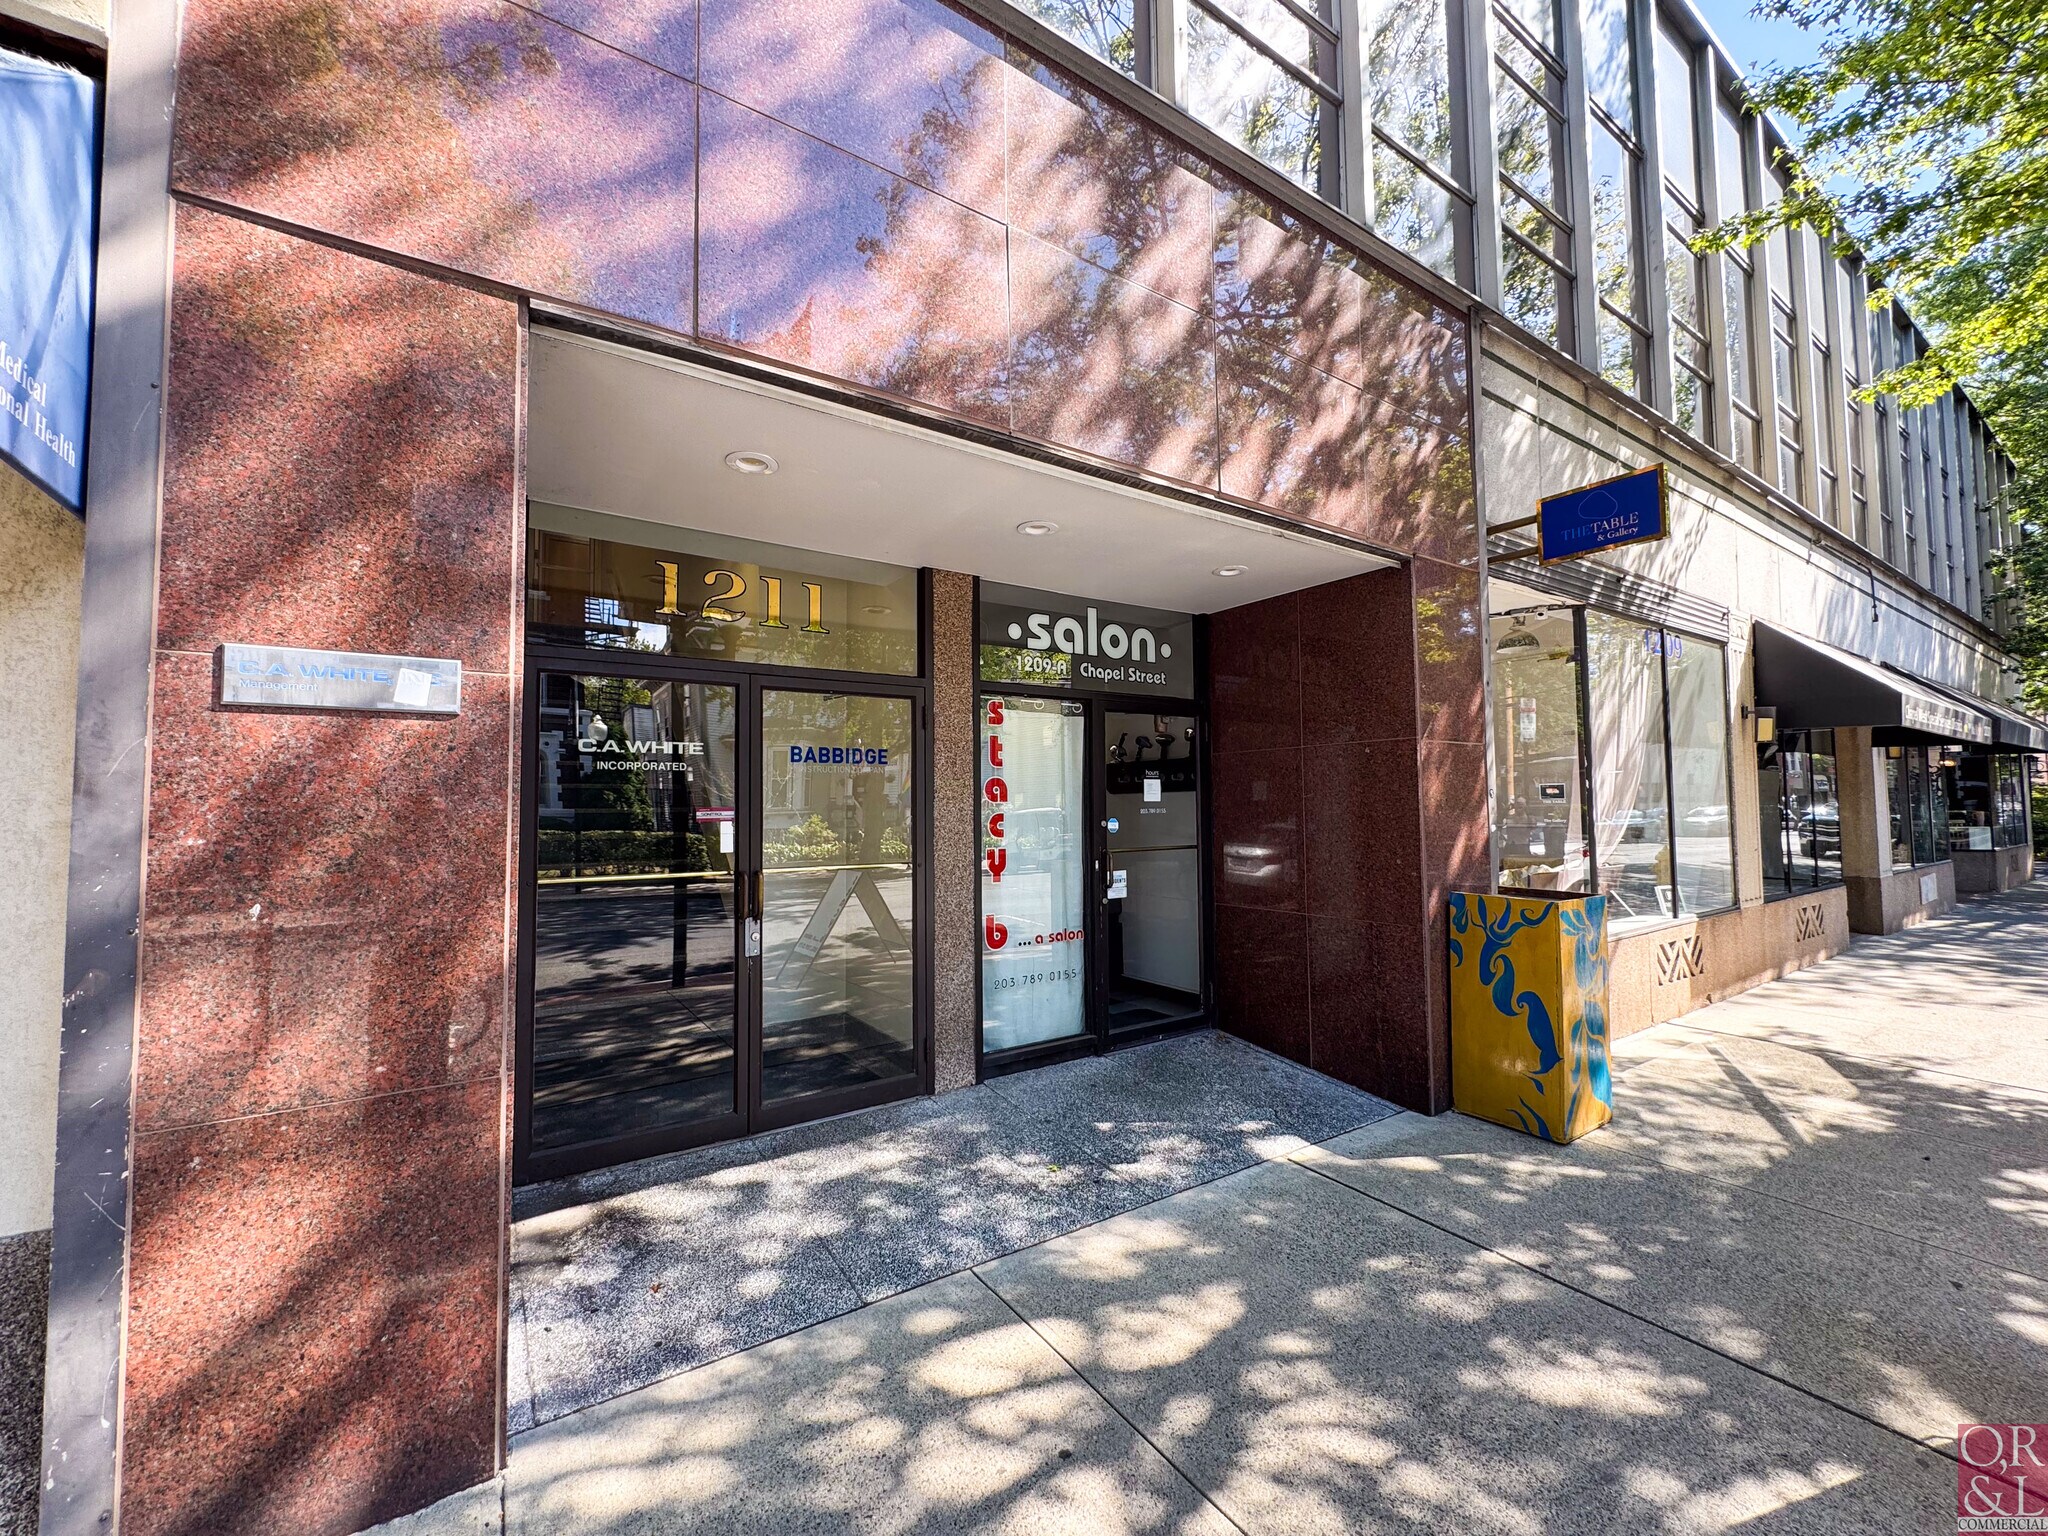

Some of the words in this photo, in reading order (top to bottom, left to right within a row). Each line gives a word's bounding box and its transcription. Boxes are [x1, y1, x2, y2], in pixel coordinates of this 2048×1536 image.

[34, 410, 76, 468] Health
[1596, 533, 1606, 542] &
[1607, 526, 1639, 539] Gallery
[654, 560, 831, 635] 1211
[238, 660, 294, 678] C.A.
[1079, 662, 1124, 683] Chapel
[1128, 667, 1167, 685] Street
[238, 678, 319, 692] Management
[790, 745, 889, 765] BABBIDGE
[596, 761, 687, 772] INCORPORATED
[1034, 934, 1044, 944] a
[1048, 928, 1084, 944] salon
